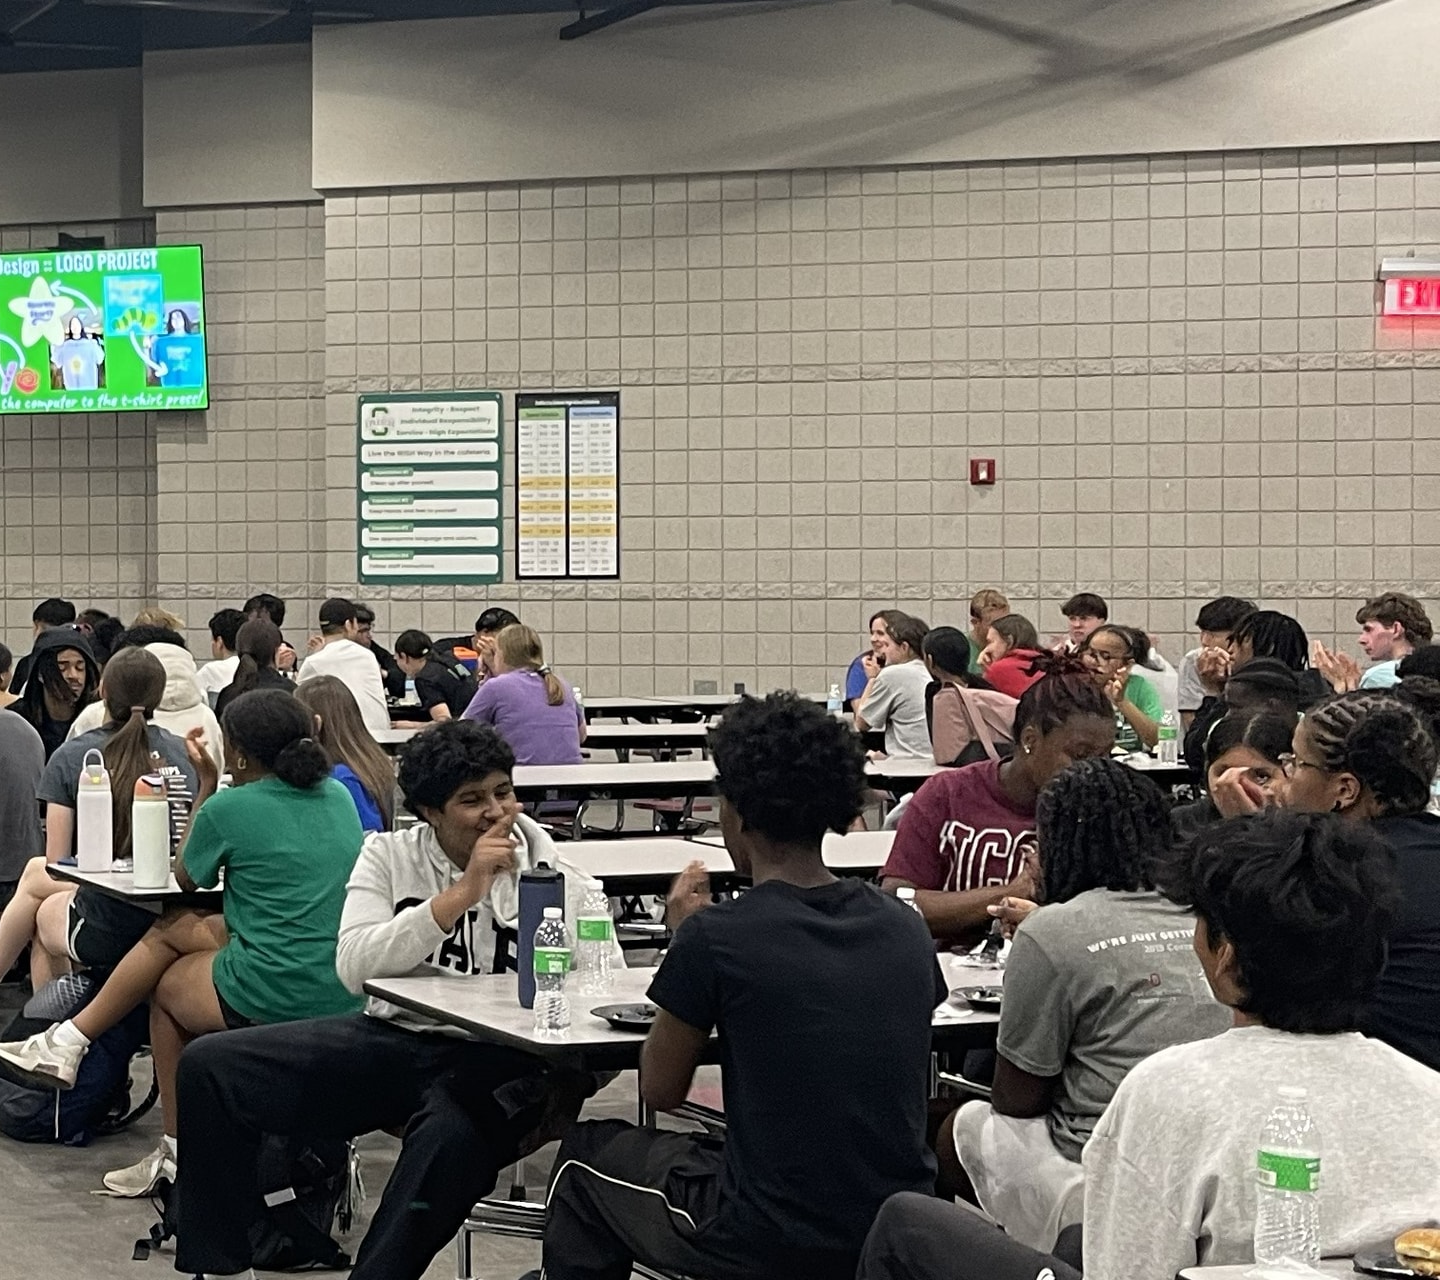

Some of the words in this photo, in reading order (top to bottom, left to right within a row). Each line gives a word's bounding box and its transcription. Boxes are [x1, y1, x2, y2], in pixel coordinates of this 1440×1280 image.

[55, 253, 93, 273] LOGO
[97, 250, 158, 271] PROJECT
[1, 396, 21, 410] the
[24, 394, 79, 411] computer
[81, 396, 94, 408] to
[97, 393, 118, 409] the
[121, 392, 164, 408] t-shirt
[1086, 935, 1128, 953] WE'RE
[1130, 931, 1158, 943] JUST
